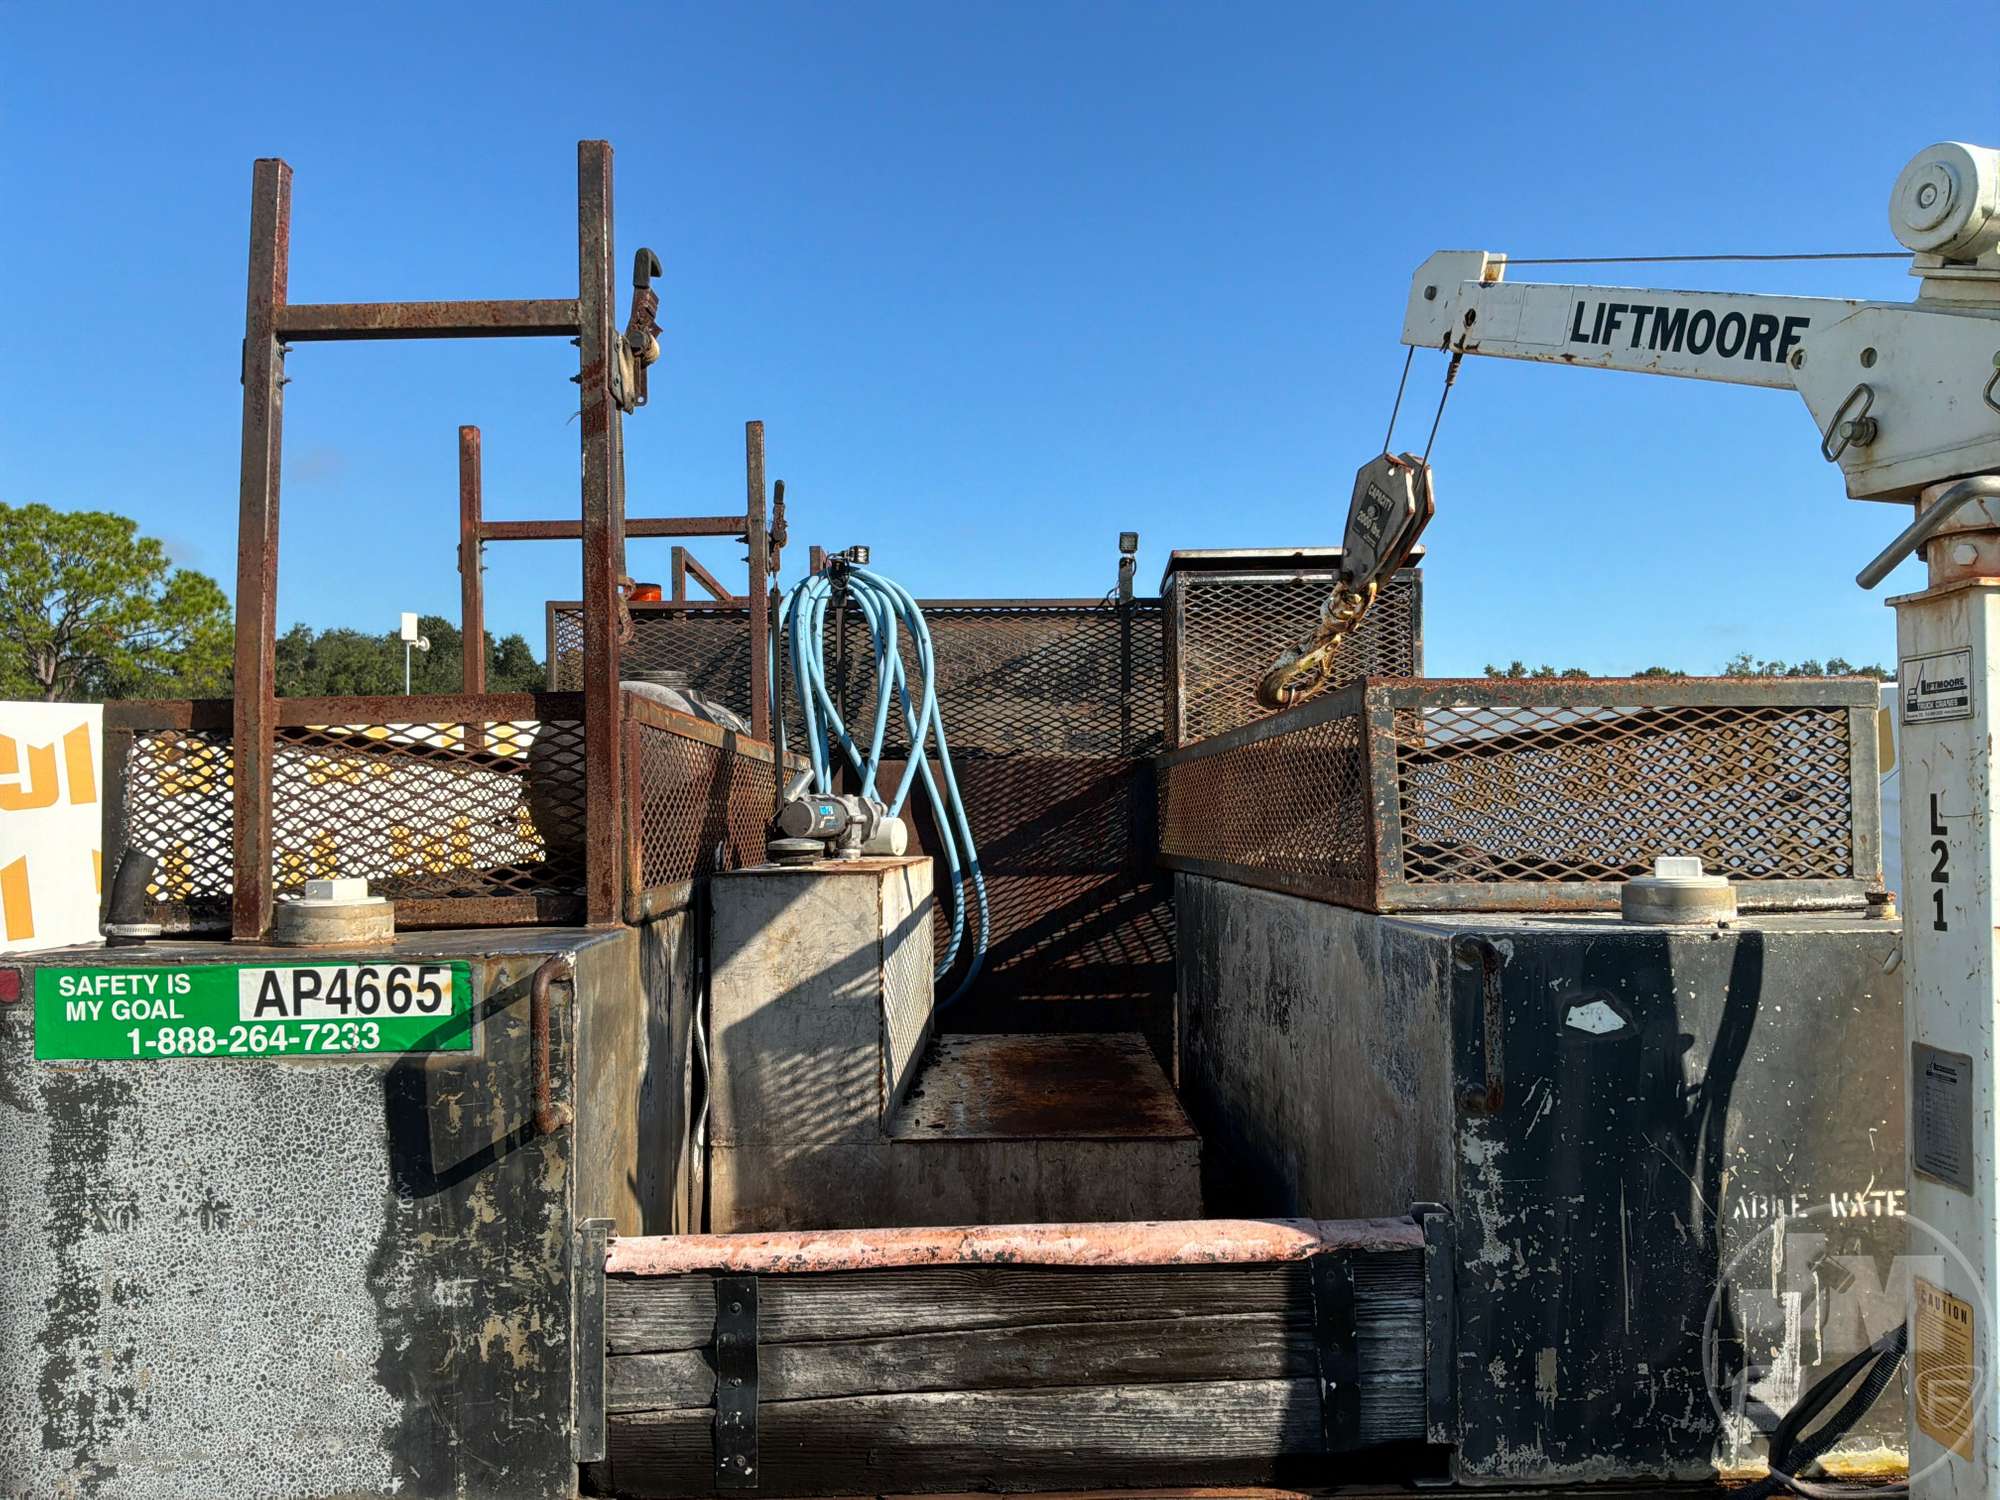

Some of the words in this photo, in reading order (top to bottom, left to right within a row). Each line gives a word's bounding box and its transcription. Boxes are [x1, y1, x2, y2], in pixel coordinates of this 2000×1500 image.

[58, 974, 163, 998] SAFETY
[167, 973, 192, 995] IS
[253, 966, 443, 1018] AP4665
[66, 1000, 107, 1022] MY
[111, 999, 185, 1021] GOAL
[127, 1022, 381, 1055] 1-888-264-7233
[1920, 1290, 1968, 1325] CAUTION
